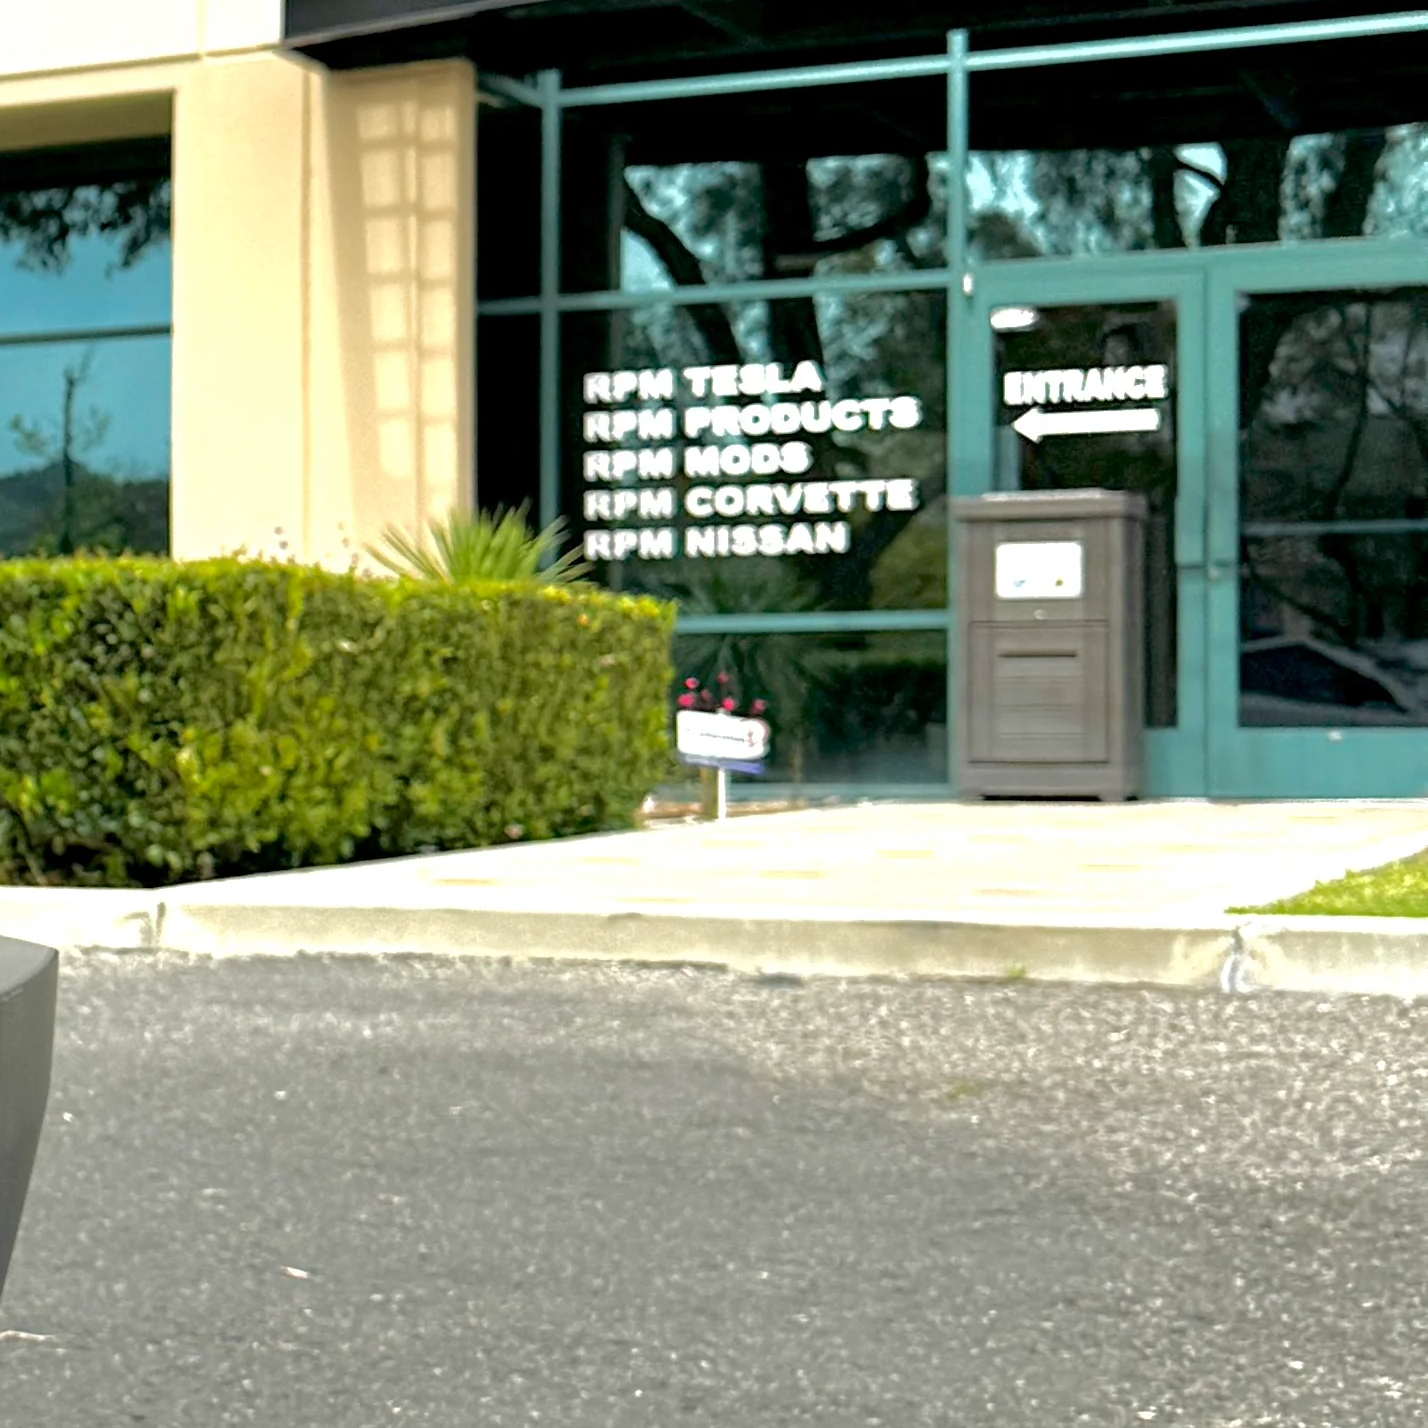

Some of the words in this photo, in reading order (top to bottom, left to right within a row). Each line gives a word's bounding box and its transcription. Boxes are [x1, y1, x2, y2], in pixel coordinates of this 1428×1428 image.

[583, 368, 675, 404] RPM
[683, 360, 824, 398] TESLA
[1003, 364, 1169, 406] ENTRANCE
[583, 407, 675, 443] RPM
[683, 396, 923, 439] PRODUCTS
[583, 446, 675, 482] RPM
[683, 440, 813, 479] MODS
[583, 486, 675, 521] RPM
[683, 479, 920, 517] CORVETTE
[583, 526, 675, 562] RPM
[683, 521, 851, 558] NISSAN
